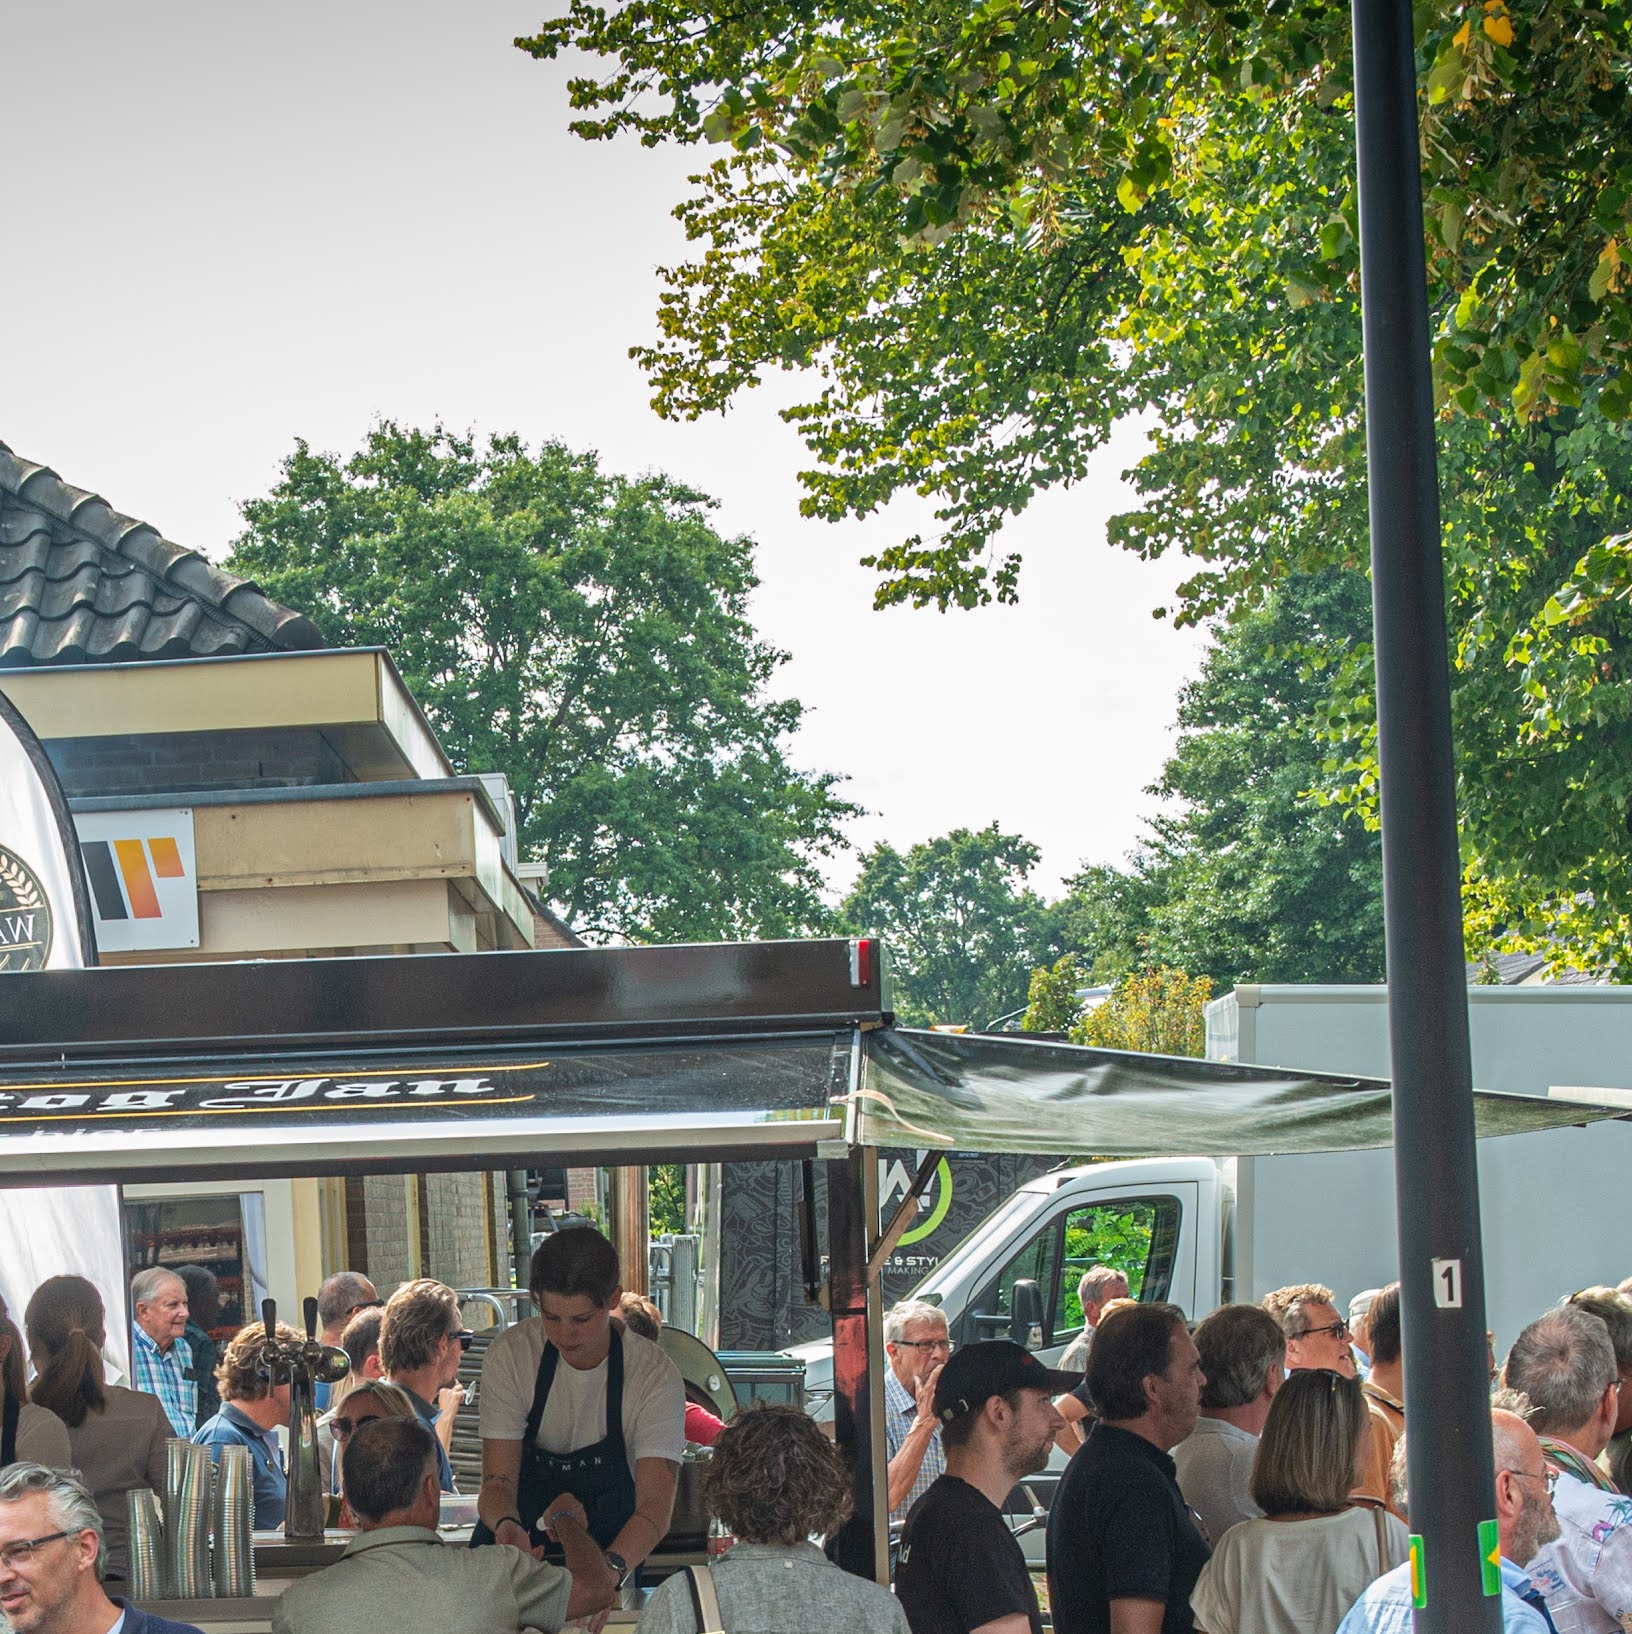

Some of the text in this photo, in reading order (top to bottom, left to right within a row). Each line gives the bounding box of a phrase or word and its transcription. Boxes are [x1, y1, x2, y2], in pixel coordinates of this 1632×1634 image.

[199, 1077, 496, 1110] Jan
[888, 1266, 928, 1275] MAKING
[1440, 1266, 1456, 1302] 1
